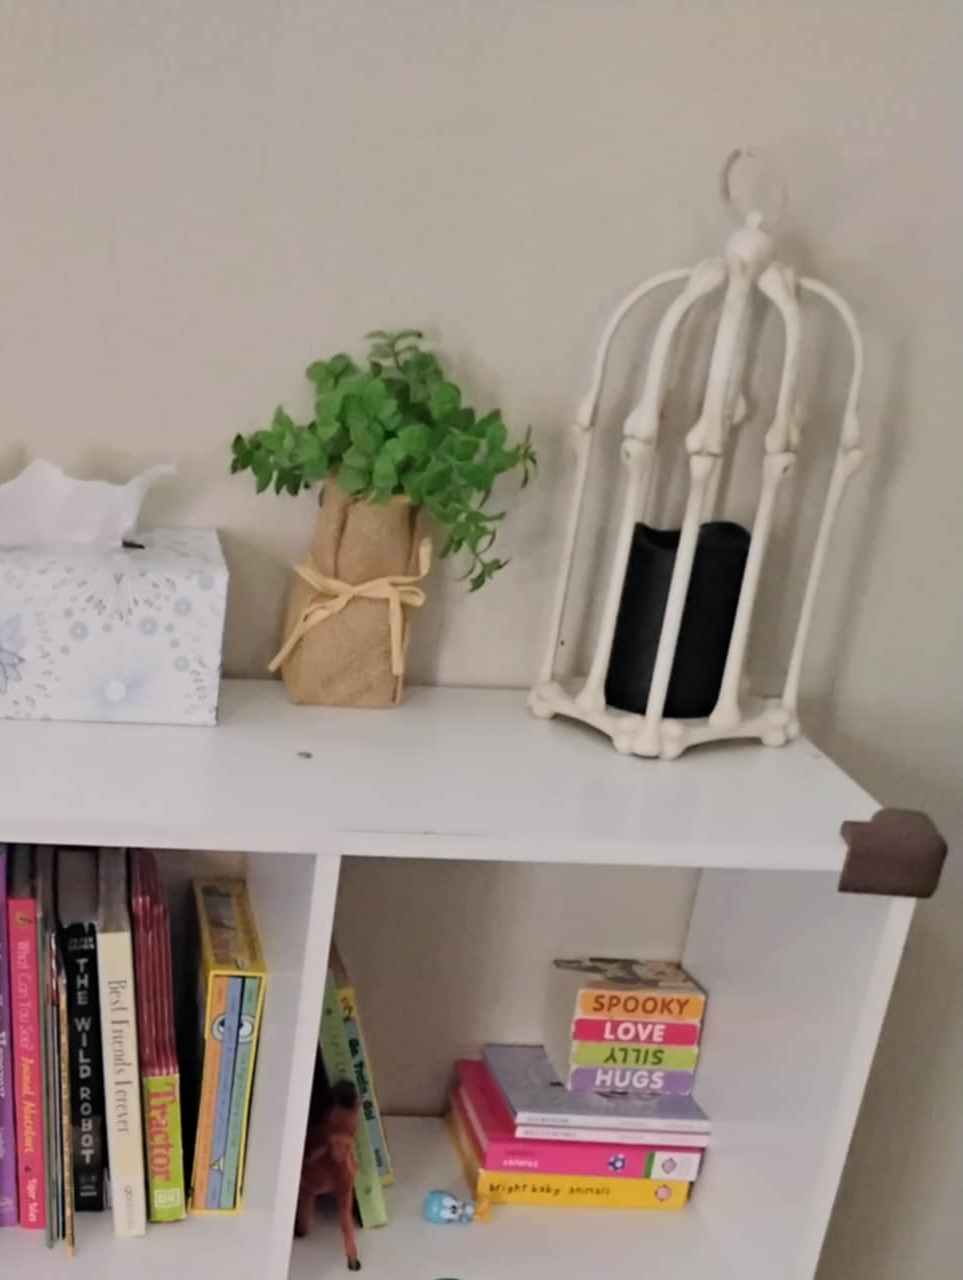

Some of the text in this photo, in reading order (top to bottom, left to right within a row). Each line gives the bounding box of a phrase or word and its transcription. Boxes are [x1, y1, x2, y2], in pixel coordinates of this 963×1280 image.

[14, 940, 31, 969] What
[16, 973, 32, 996] Can
[17, 1000, 33, 1022] You
[592, 994, 690, 1015] SPOOKY
[603, 1022, 667, 1042] LOVE
[73, 958, 95, 1164] THE WILD ROBOT
[107, 979, 134, 1133] Best Friends Forever
[604, 1047, 665, 1066] SILLY
[20, 1054, 38, 1096] Animal
[595, 1069, 665, 1090] HUGS
[145, 1082, 181, 1182] Tractor
[26, 1179, 39, 1222] Tiger Tales
[489, 1182, 610, 1196] bright baby animals
